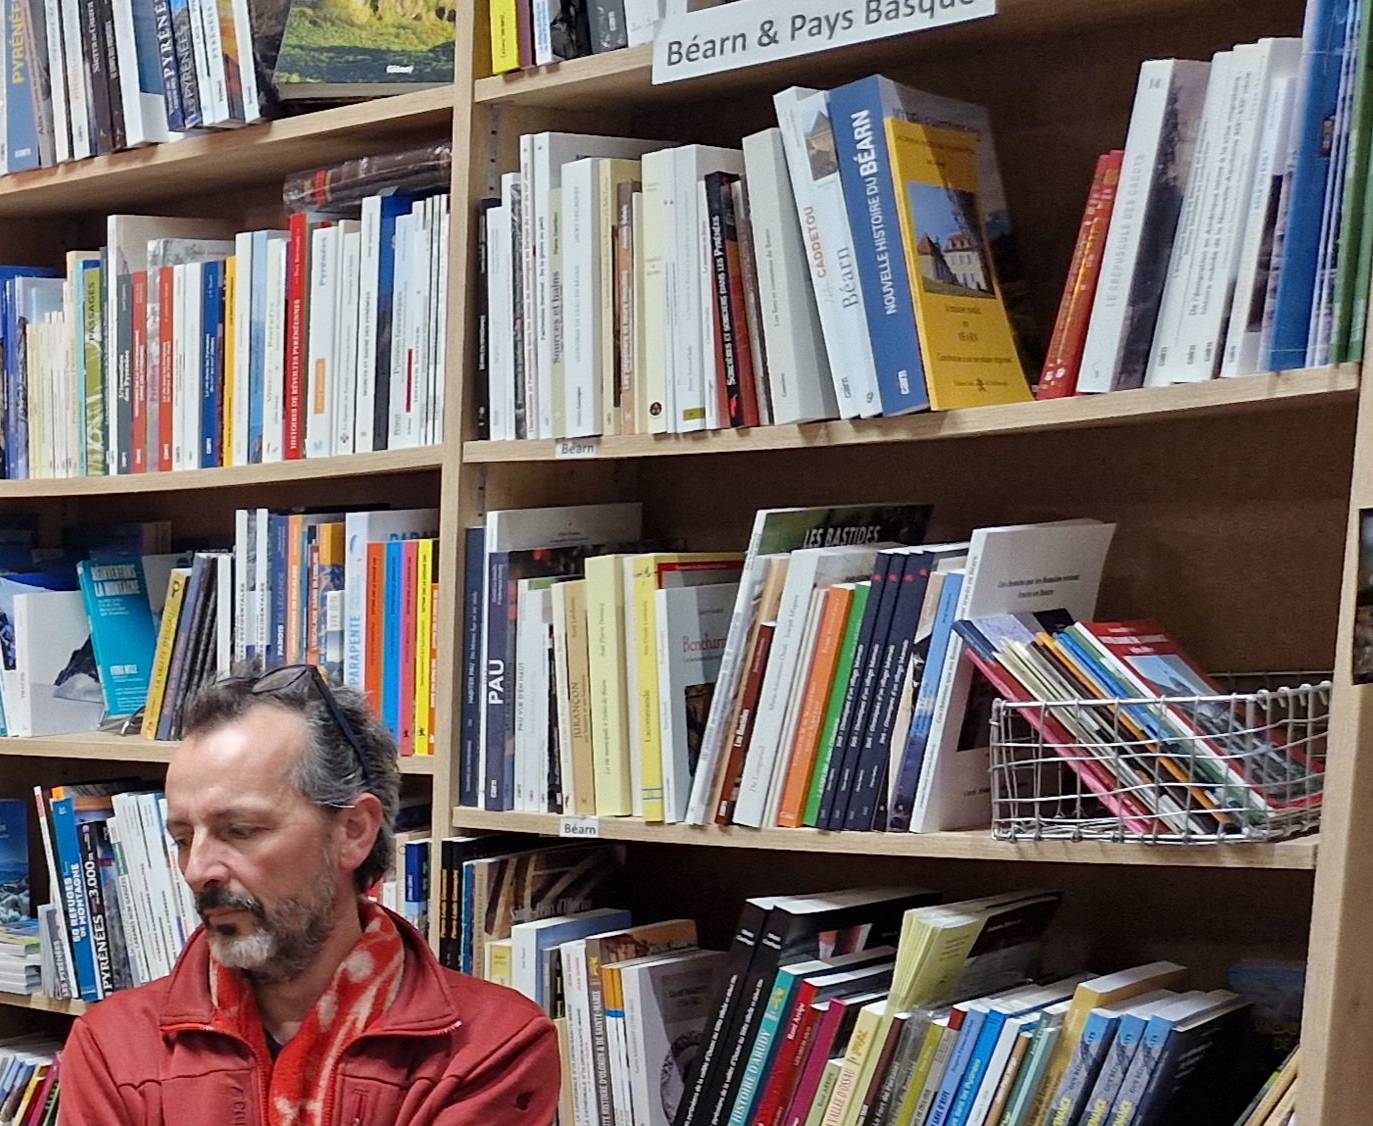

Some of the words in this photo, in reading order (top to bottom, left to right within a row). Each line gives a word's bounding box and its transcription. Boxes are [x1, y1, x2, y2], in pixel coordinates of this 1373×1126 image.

[91, 41, 101, 73] Sierra
[666, 33, 748, 67] Béarn
[757, 18, 779, 48] &
[790, 9, 855, 41] Pays
[852, 108, 874, 180] BÉARN
[864, 177, 878, 194] DU
[804, 206, 827, 279] CADDETOU
[868, 196, 887, 251] HISTOIRE
[551, 271, 561, 302] bains
[718, 273, 729, 294] DANS
[835, 246, 860, 308] Béarn
[874, 252, 898, 315] NOUVELLE
[551, 319, 561, 363] Sources
[291, 356, 300, 395] RÉVOLTES
[291, 396, 298, 407] DE
[561, 442, 595, 455] Béarn
[804, 529, 823, 548] LES
[827, 524, 880, 544] BASTIDES
[276, 625, 284, 656] PAROIS
[349, 615, 361, 686] PARAPENTE
[488, 659, 505, 705] PAU
[570, 681, 582, 740] JURANÇON
[564, 821, 598, 836] Béarn
[72, 863, 87, 925] MONTAGNE
[84, 861, 98, 898] 3.000
[63, 877, 79, 927] REFUGES
[72, 929, 82, 943] 50
[80, 926, 87, 937] DE
[90, 914, 113, 990] PYRÉNÉES
[591, 990, 604, 1035] SAINTE-MARIE
[787, 1023, 799, 1040] René
[597, 1053, 608, 1084] D'OLORON
[732, 1076, 757, 1122] HISTOIRE
[748, 1029, 771, 1074] D'ARUDY
[600, 1085, 610, 1116] HISTOIRE
[825, 1098, 846, 1124] VALLÉE
[836, 1068, 856, 1098] D'OSSAU
